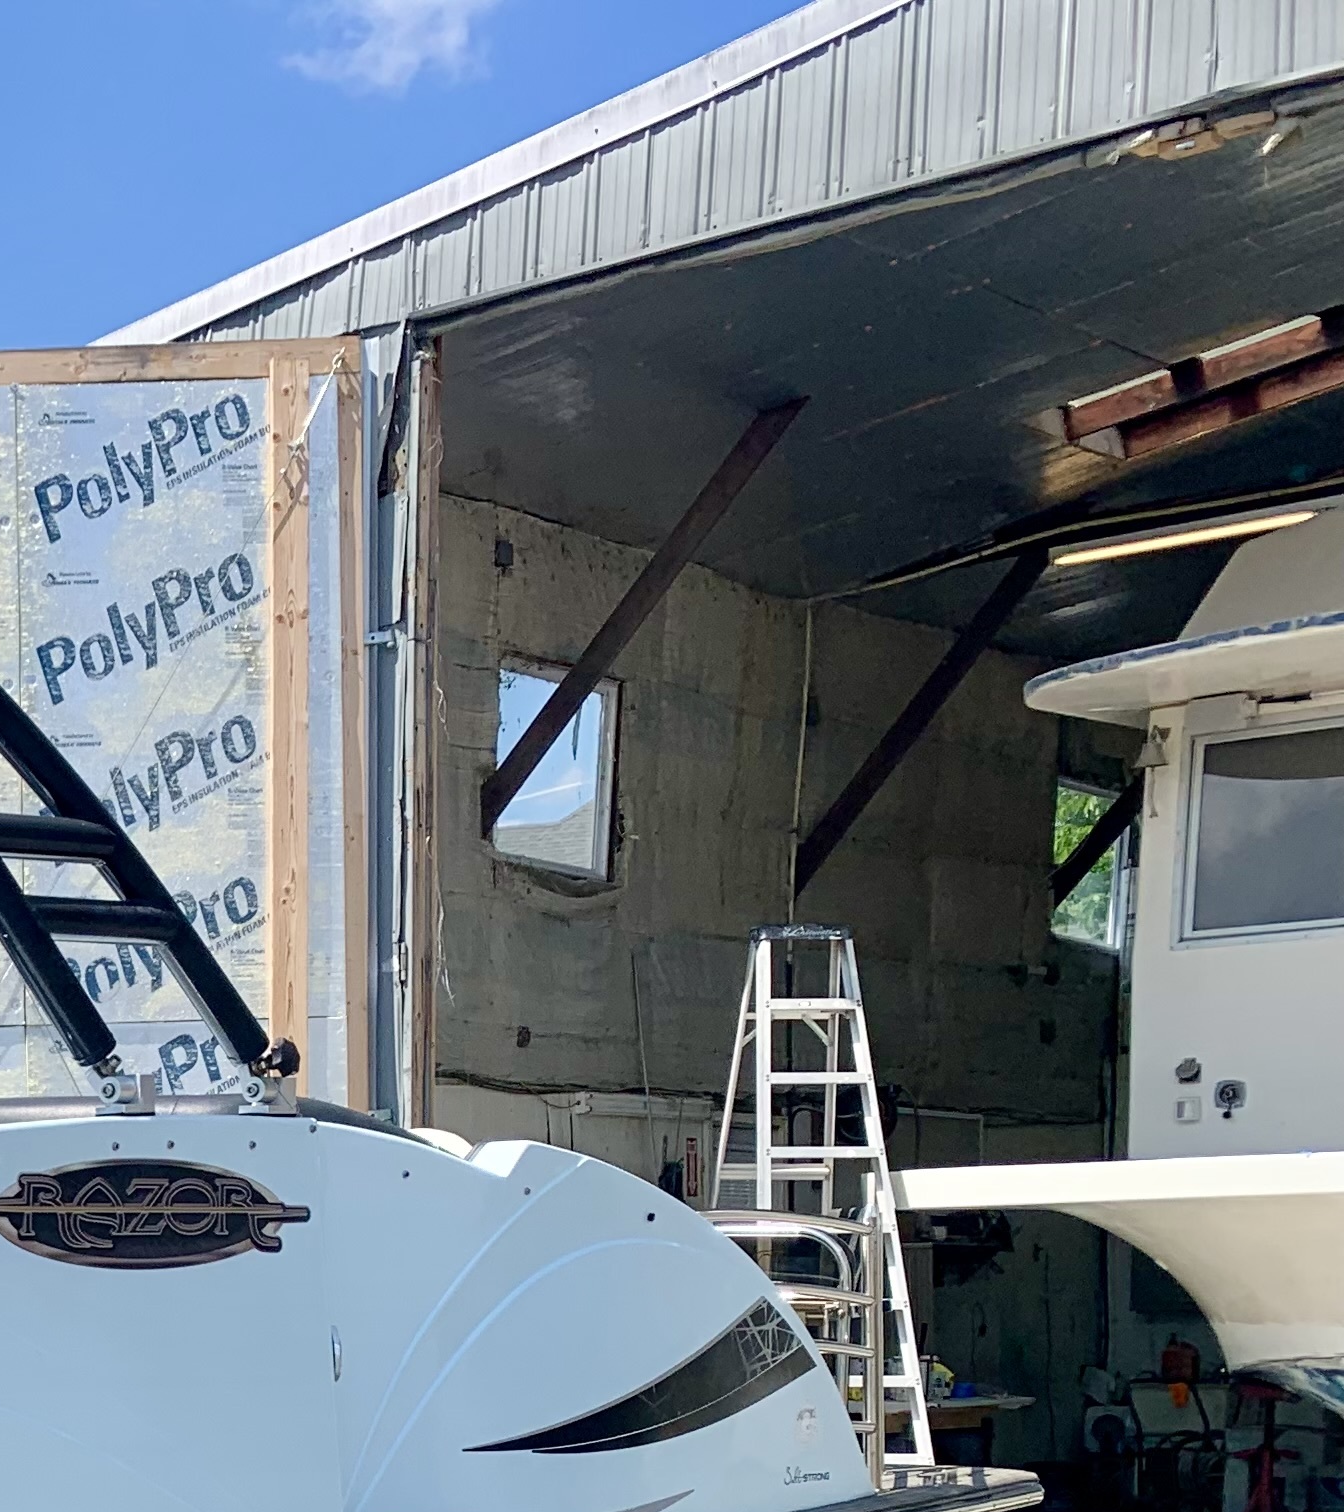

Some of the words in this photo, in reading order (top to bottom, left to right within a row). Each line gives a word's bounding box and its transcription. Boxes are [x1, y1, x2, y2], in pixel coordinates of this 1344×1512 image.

[34, 393, 251, 544] PolyPro
[182, 446, 231, 480] INSULATION
[233, 431, 257, 452] FOAM
[36, 553, 254, 705] PolyPro
[237, 593, 260, 613] FOAM
[173, 798, 187, 814] EPS
[188, 769, 238, 803] INSULATION
[18, 1174, 282, 1251] RAZOR
